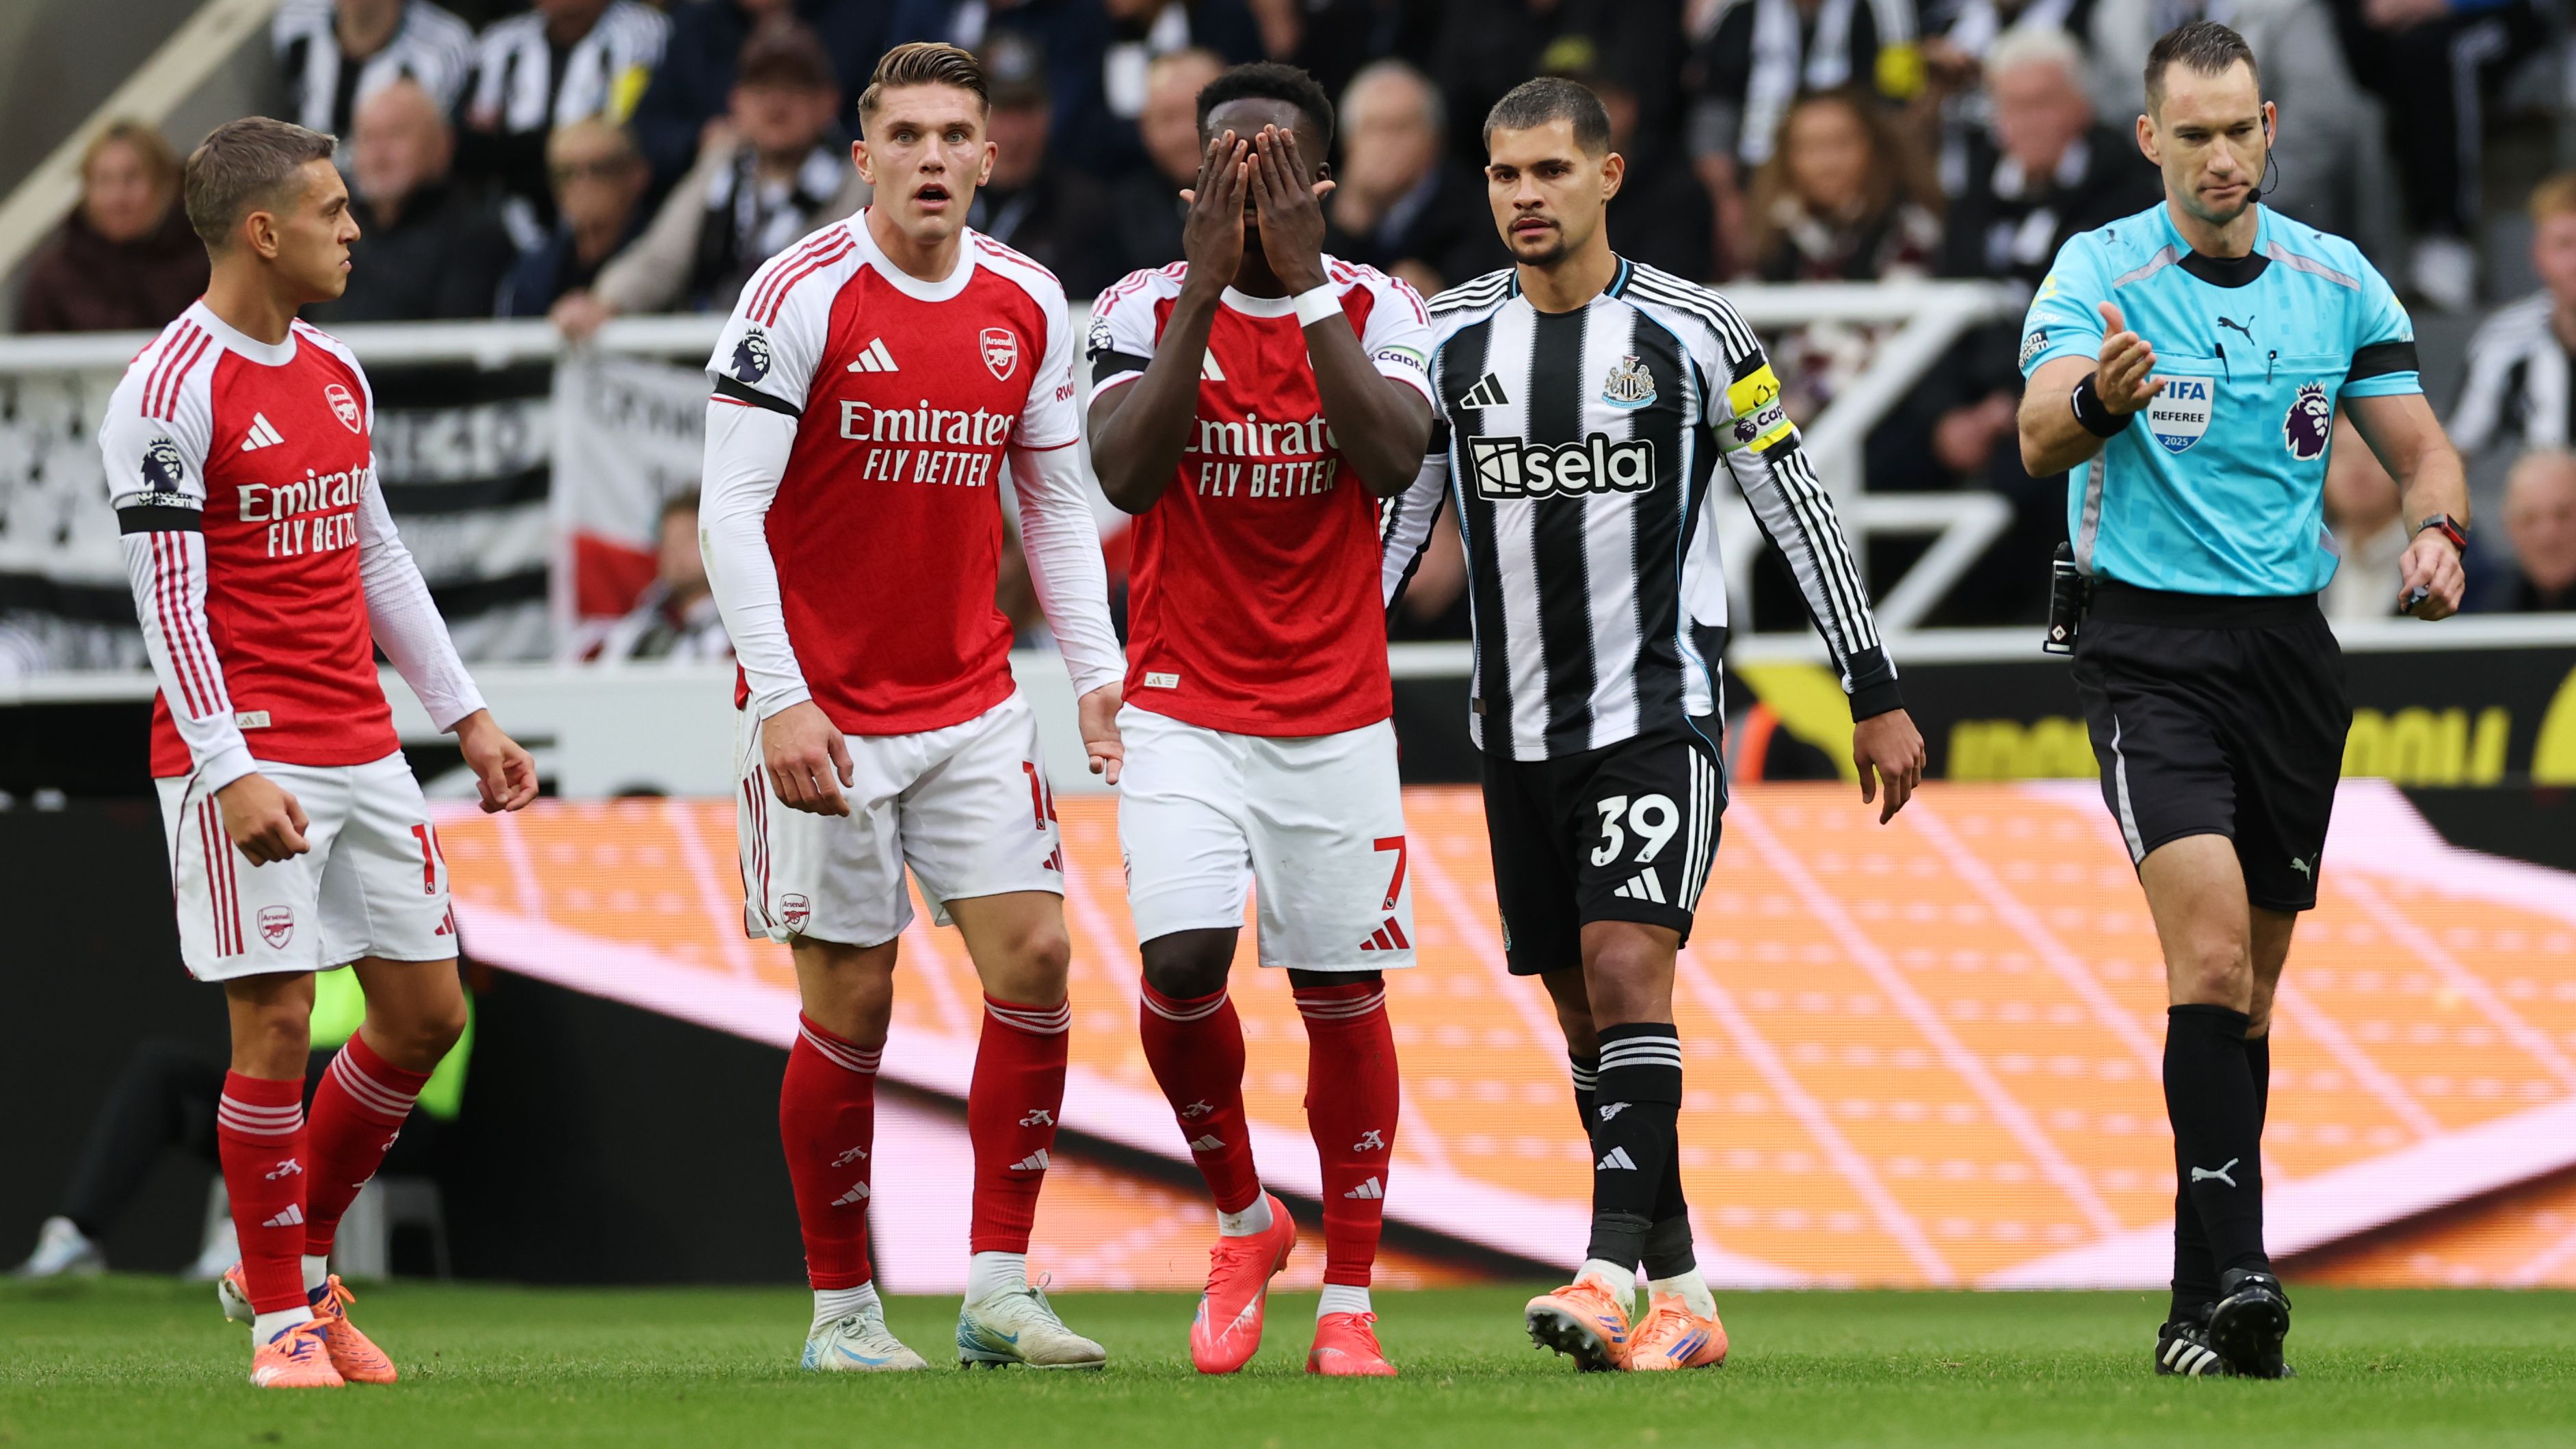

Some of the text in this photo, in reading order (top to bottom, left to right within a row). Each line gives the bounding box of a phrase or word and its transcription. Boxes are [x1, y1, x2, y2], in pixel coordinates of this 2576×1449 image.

[986, 337, 1012, 345] Arsenal
[839, 399, 1014, 445] Emirates
[2153, 410, 2205, 423] REFEREE
[2164, 436, 2188, 446] 2025
[863, 449, 992, 487] FLY BETTER
[1198, 458, 1337, 497] FLY BETTER
[1525, 439, 1647, 492] sela
[267, 519, 306, 558] FLY
[1590, 793, 1680, 867] 39
[1374, 835, 1406, 911] 7
[263, 913, 289, 921] Arsenal
